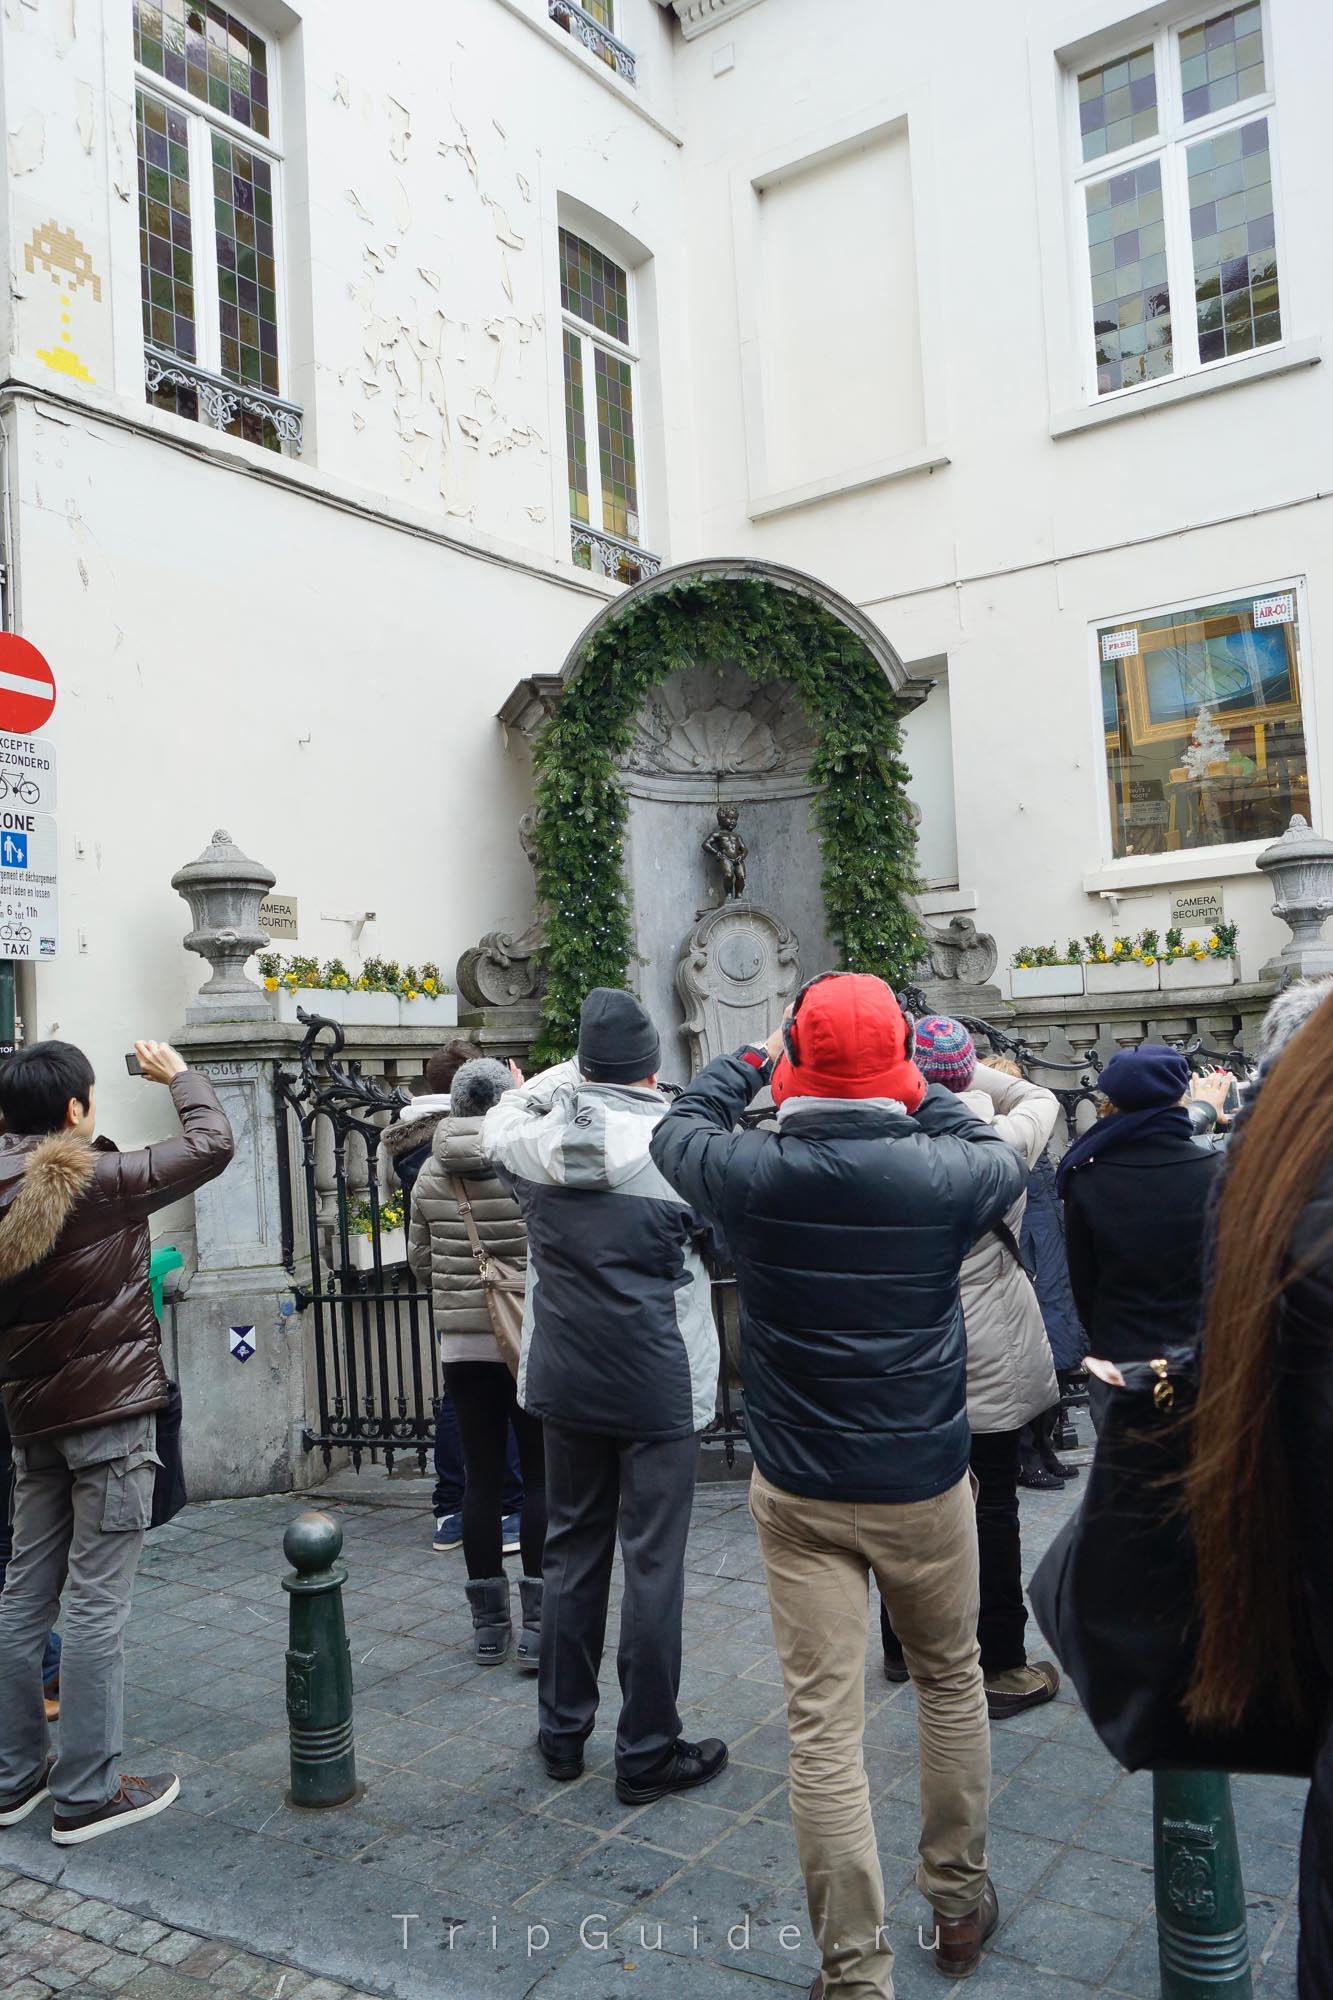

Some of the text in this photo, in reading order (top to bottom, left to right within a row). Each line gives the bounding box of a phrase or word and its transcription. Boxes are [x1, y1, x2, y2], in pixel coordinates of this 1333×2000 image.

[1259, 603, 1287, 618] AIR-CO
[1108, 640, 1132, 651] FREE
[0, 812, 35, 832] ONE
[1176, 895, 1217, 908] CAMERA
[7, 904, 13, 916] 6
[260, 903, 292, 915] AMERA
[1172, 906, 1223, 920] SECURITY!
[3, 942, 29, 956] TAXI
